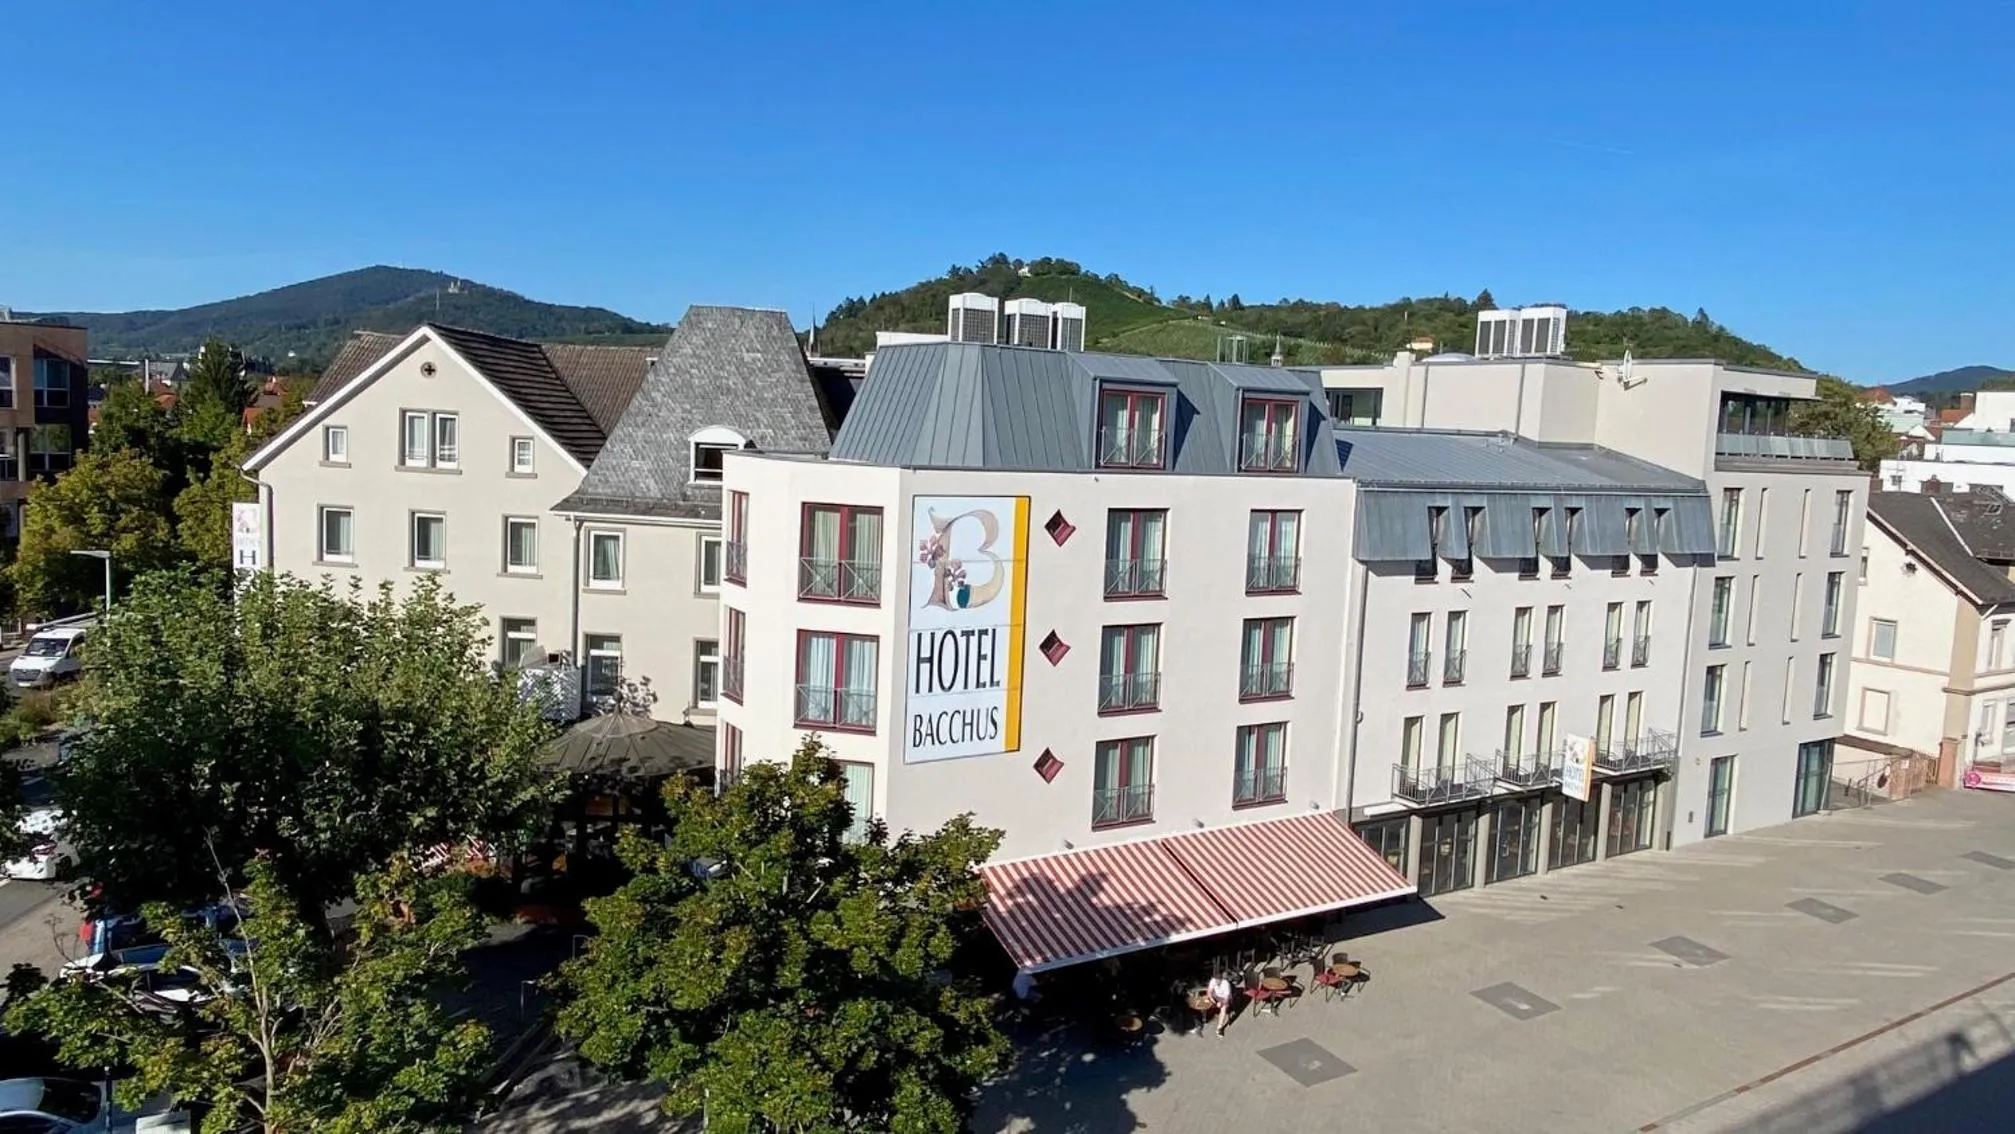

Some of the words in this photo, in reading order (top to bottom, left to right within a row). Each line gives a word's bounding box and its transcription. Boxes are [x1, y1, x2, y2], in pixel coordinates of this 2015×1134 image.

[920, 506, 1004, 611] B
[915, 628, 1001, 694] HOTEL
[913, 706, 999, 748] BACCHUS
